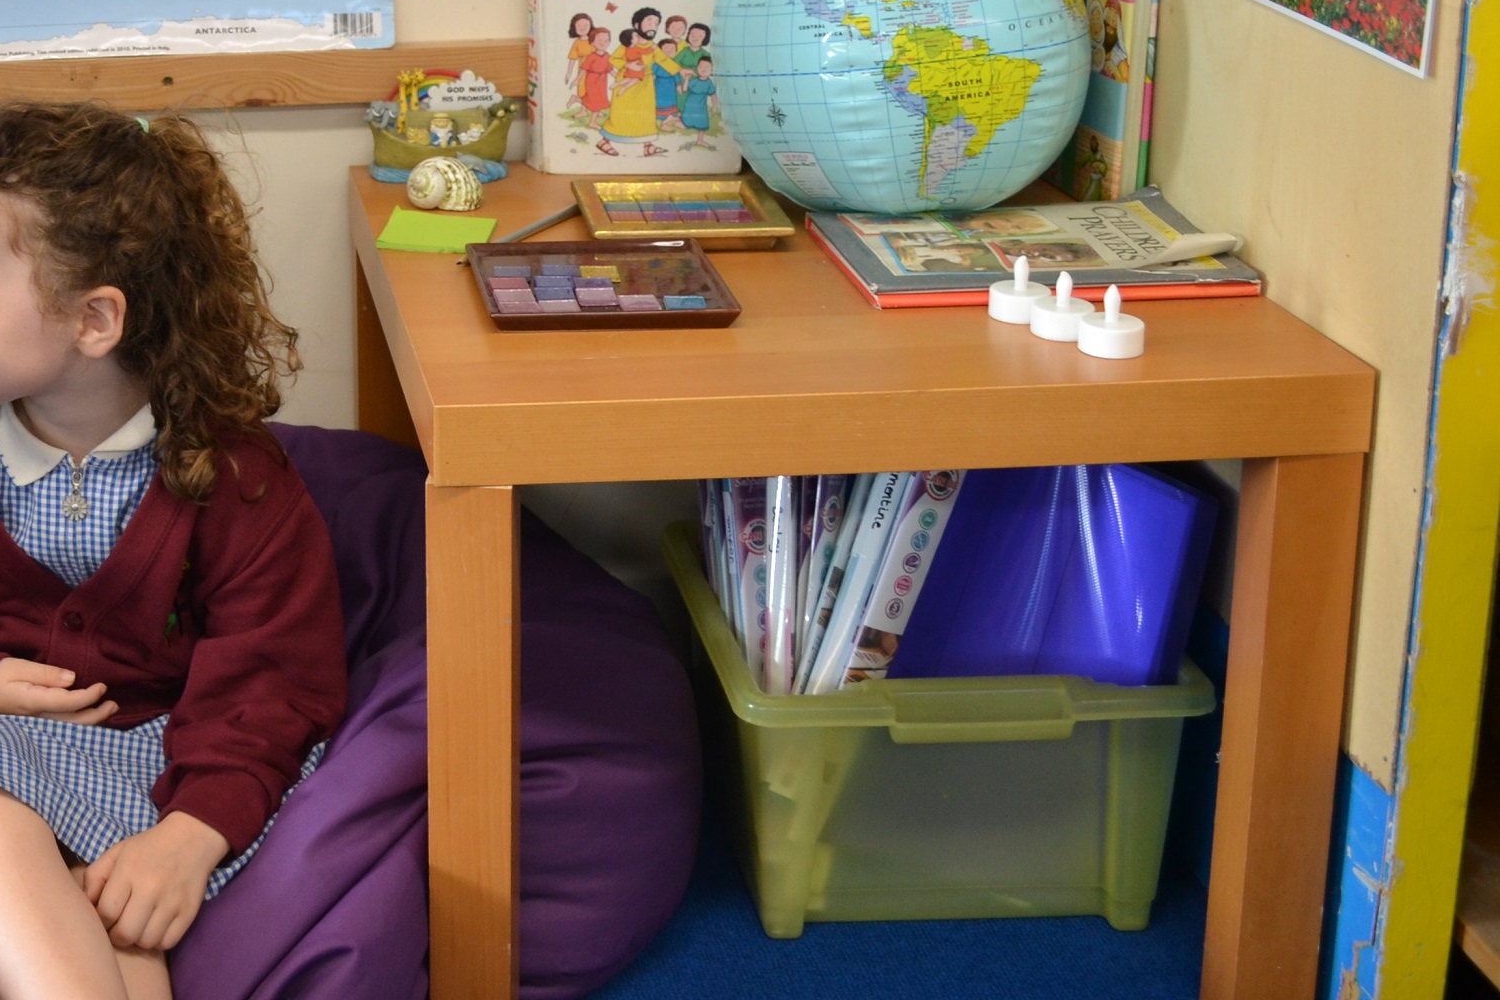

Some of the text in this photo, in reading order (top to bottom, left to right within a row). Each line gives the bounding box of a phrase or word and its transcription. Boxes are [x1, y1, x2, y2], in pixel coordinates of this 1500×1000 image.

[195, 26, 257, 36] ANTARCTICA
[948, 78, 983, 88] SOUTH
[447, 86, 465, 94] GOD
[945, 91, 991, 102] AMERICA
[1066, 216, 1148, 262] PRAYERS
